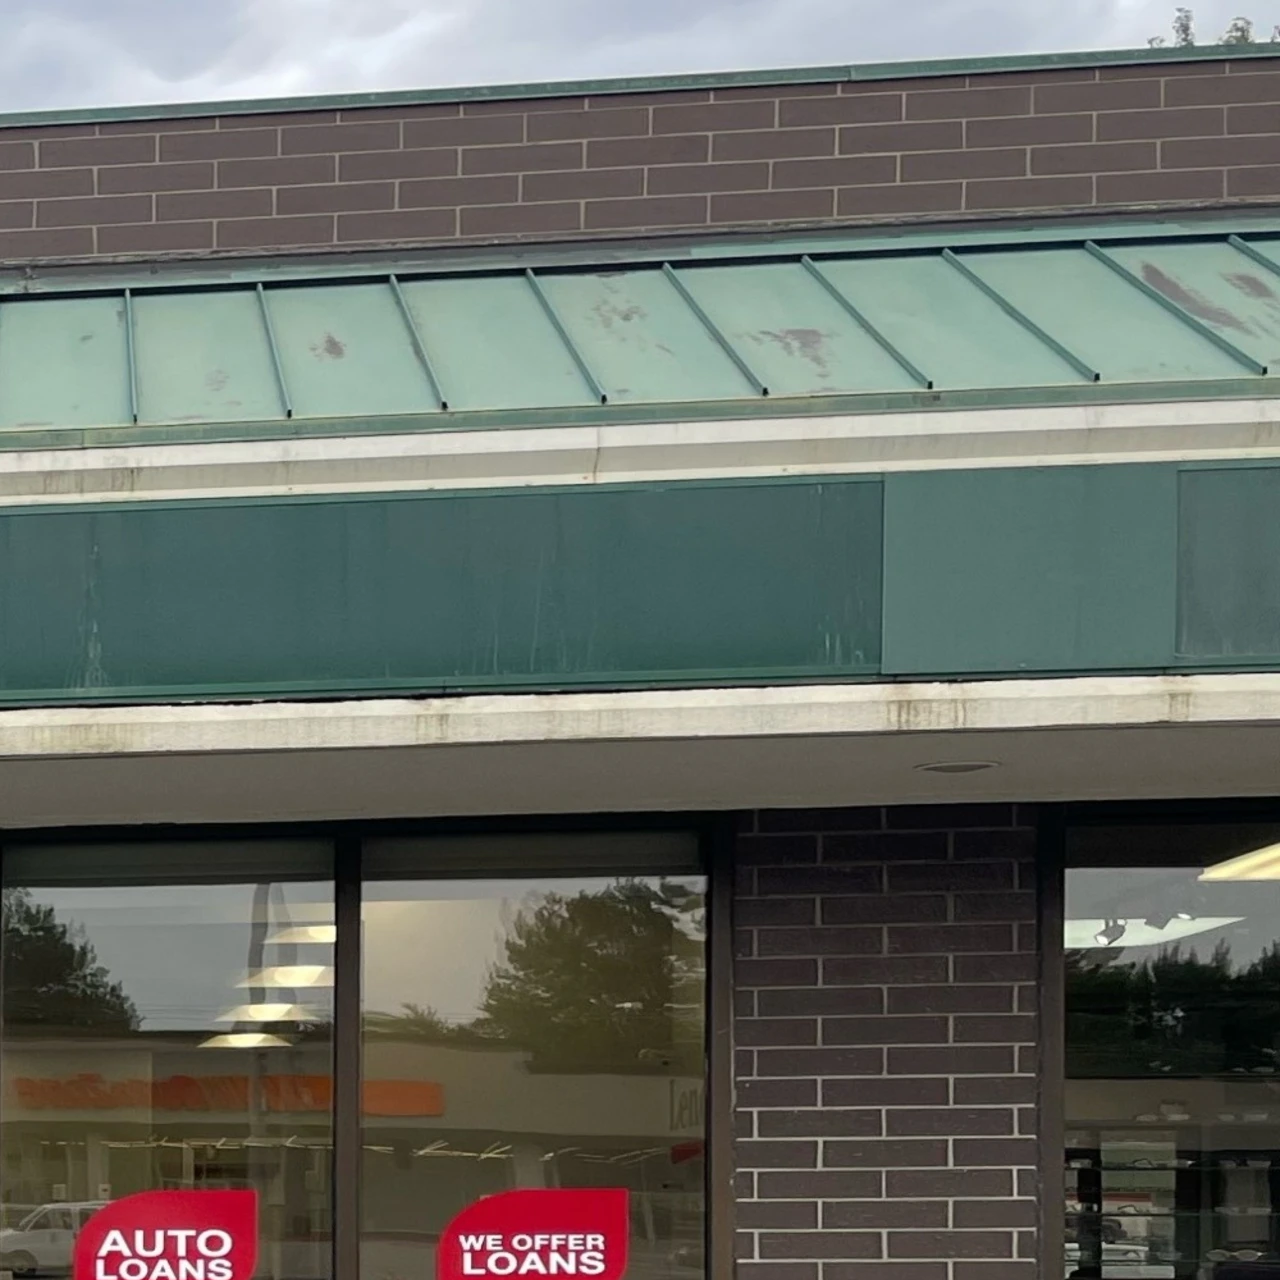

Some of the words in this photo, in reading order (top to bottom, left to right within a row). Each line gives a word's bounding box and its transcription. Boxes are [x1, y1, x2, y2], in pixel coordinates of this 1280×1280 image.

[97, 1229, 232, 1257] AUTO
[459, 1235, 503, 1250] WE
[511, 1234, 605, 1250] OFFER
[463, 1251, 605, 1275] LOANS
